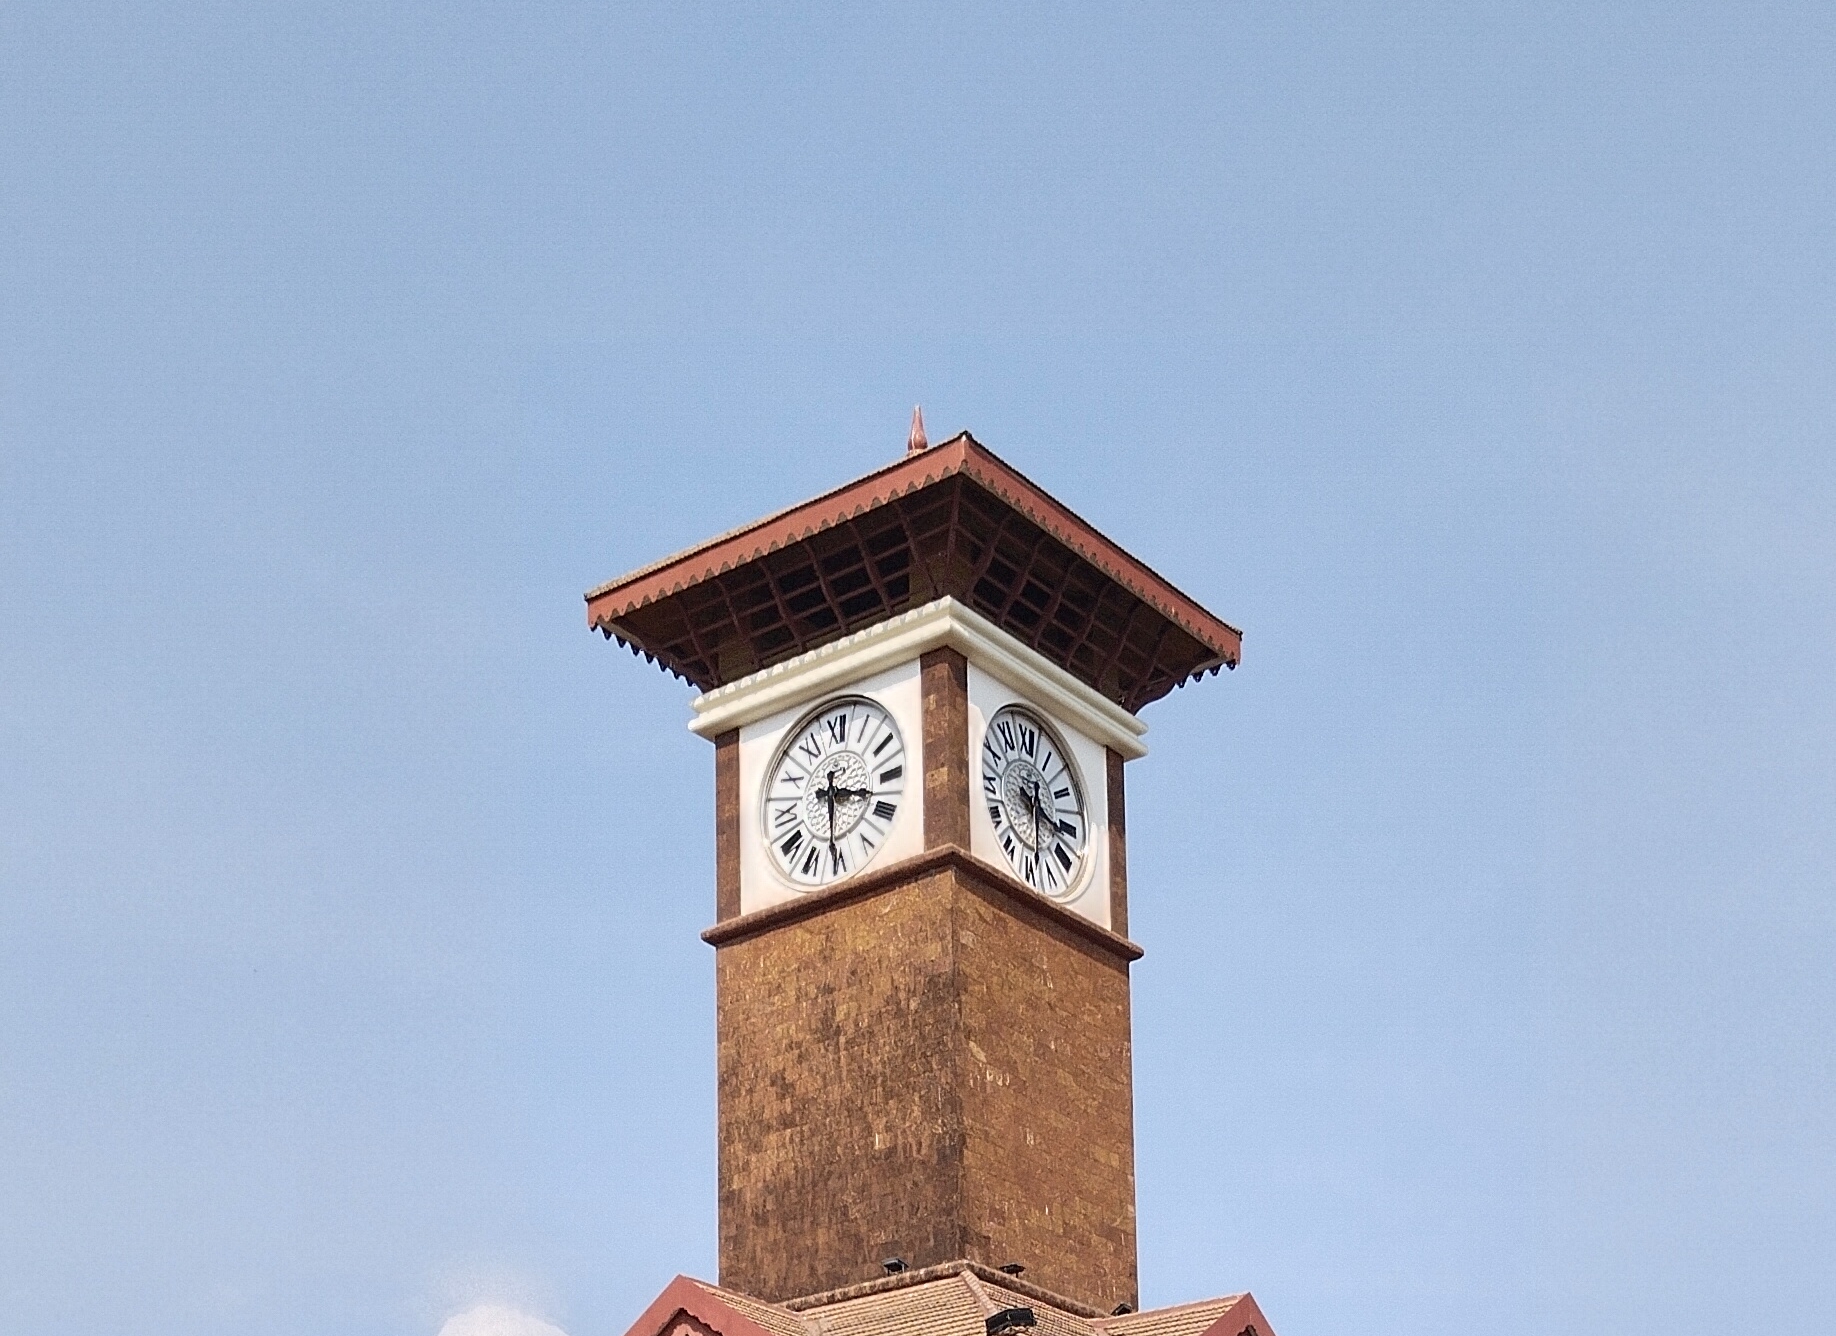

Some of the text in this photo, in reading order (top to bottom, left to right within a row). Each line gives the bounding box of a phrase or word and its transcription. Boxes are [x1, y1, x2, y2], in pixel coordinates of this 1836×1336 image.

[828, 714, 847, 748] XII
[857, 714, 870, 743] I
[997, 720, 1016, 753] XI
[1018, 723, 1035, 758] XII
[799, 732, 821, 766] XI
[984, 735, 1001, 769] X
[1041, 751, 1052, 772] I
[780, 770, 804, 790] X
[1053, 787, 1070, 800] II
[775, 802, 798, 829] IX
[860, 833, 875, 857] V
[801, 846, 820, 877] VII
[1044, 858, 1057, 888] V
